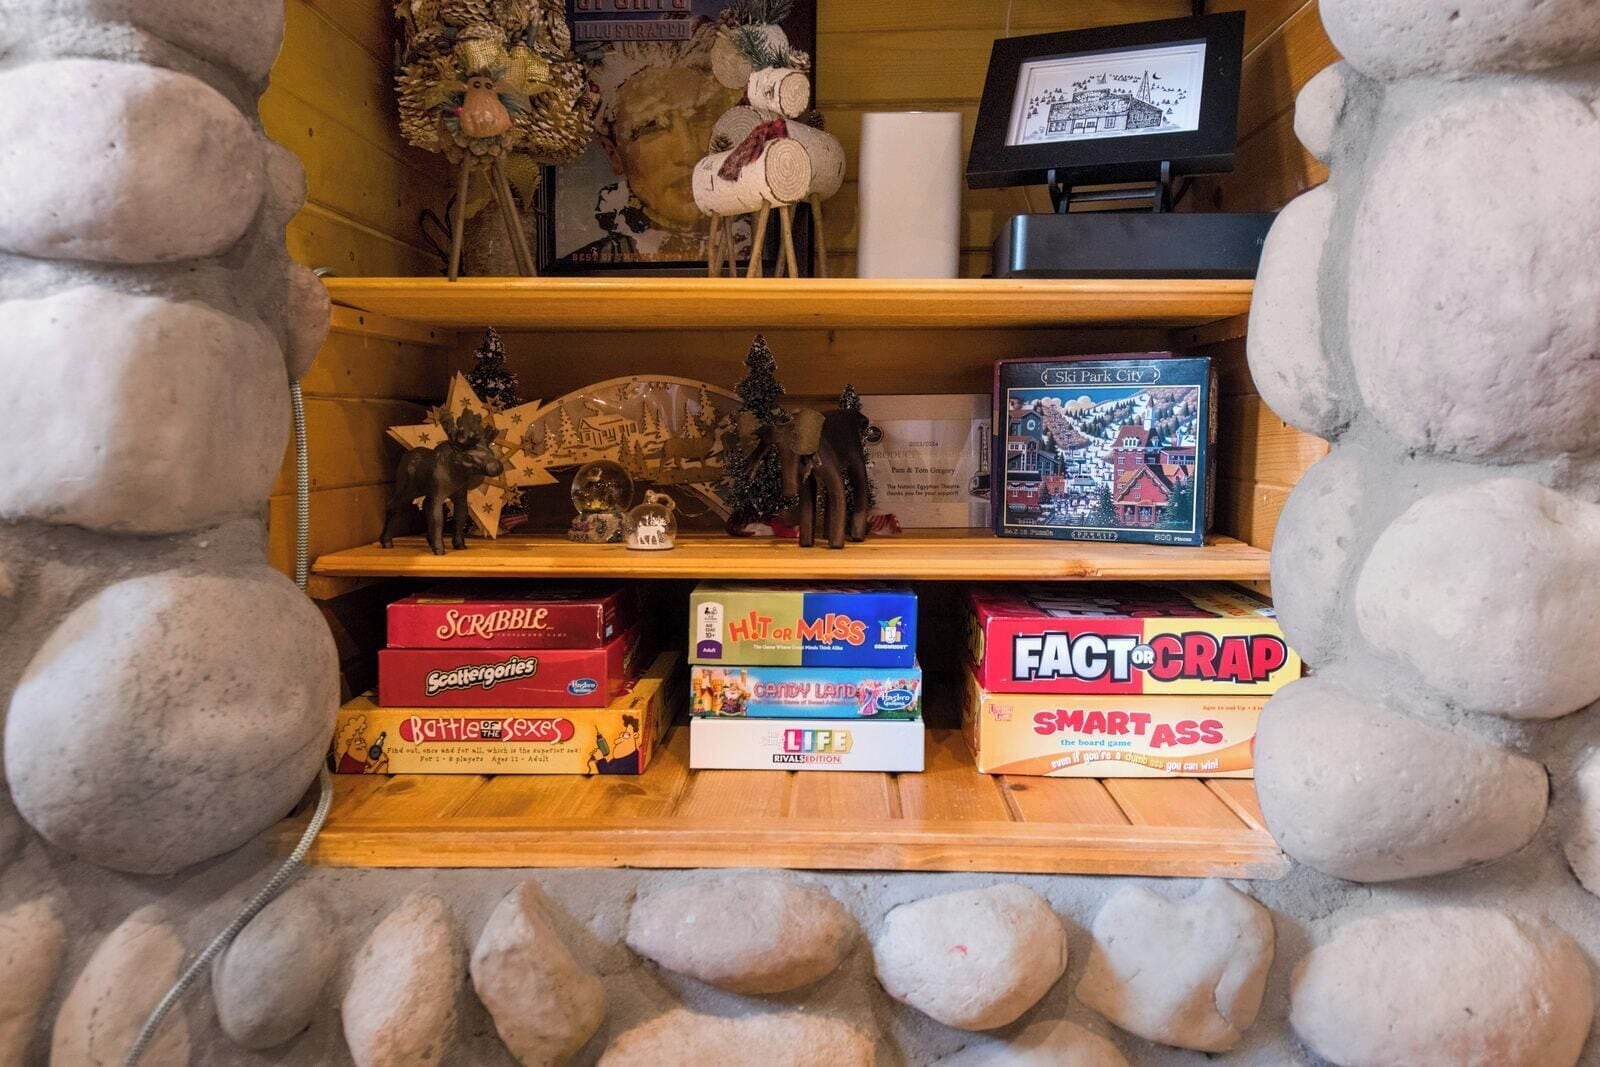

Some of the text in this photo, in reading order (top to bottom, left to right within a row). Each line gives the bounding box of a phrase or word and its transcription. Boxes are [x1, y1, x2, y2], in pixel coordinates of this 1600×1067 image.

[577, 22, 686, 39] ILLUSTRATED
[1055, 369, 1144, 383] Ski Park City
[436, 608, 548, 640] SCRABBLE
[772, 628, 793, 640] OR
[1013, 632, 1285, 682] FACT OR CRAP
[427, 656, 536, 694] Scattergories
[753, 682, 858, 699] CANDY LAND
[410, 716, 480, 745] Battle
[482, 721, 499, 729] OF
[1033, 708, 1152, 736] SMART
[1149, 719, 1224, 748] ASS
[482, 730, 500, 738] THE
[786, 730, 849, 751] LIFE
[455, 756, 483, 764] players
[491, 756, 508, 765] Ages
[533, 748, 565, 756] superior
[773, 754, 841, 763] RIVALS EDITION
[1051, 756, 1072, 769] even
[1072, 751, 1081, 763] if
[1083, 751, 1111, 764] you're
[1165, 761, 1183, 772] you
[1183, 762, 1199, 770] can
[1201, 758, 1219, 770] win!
